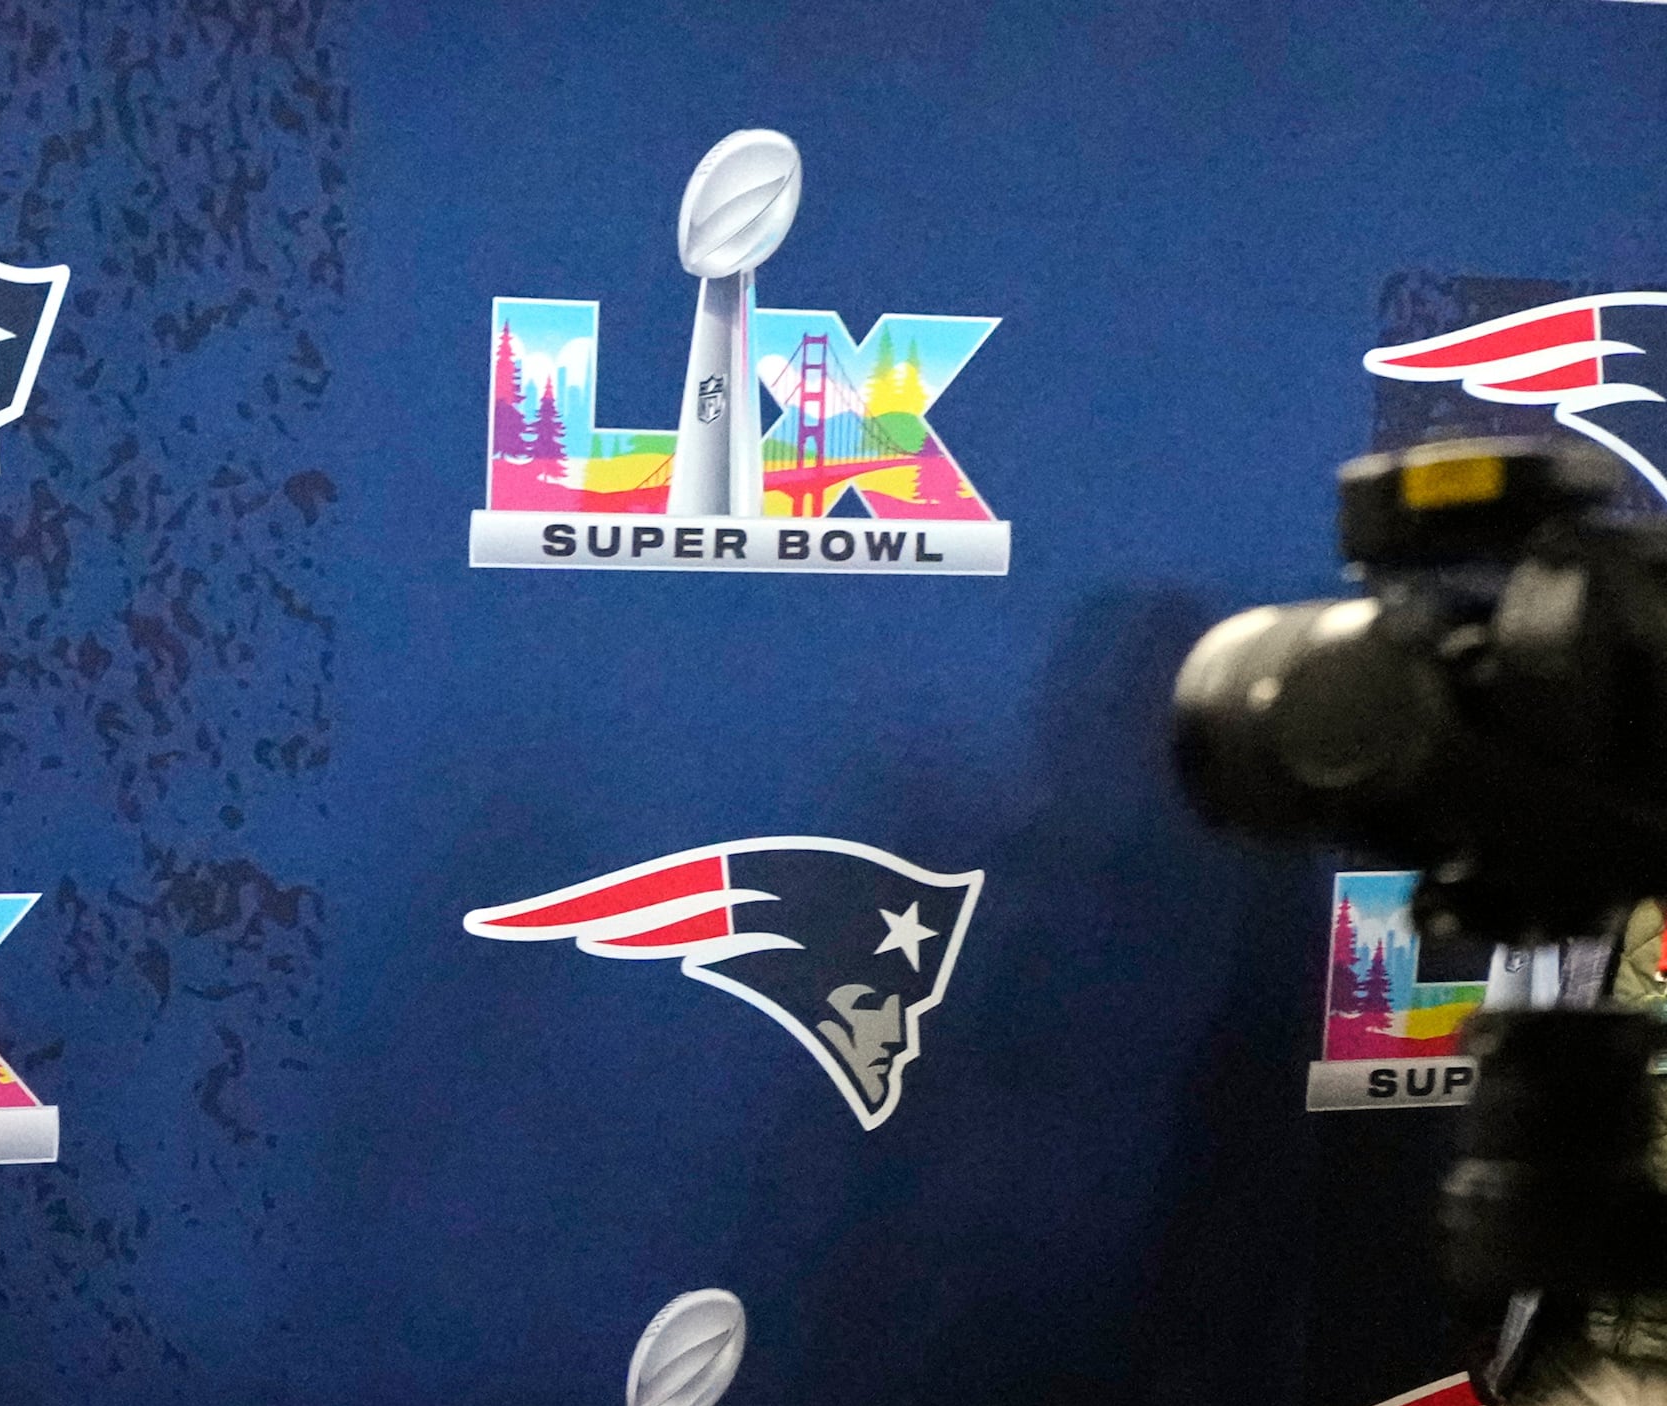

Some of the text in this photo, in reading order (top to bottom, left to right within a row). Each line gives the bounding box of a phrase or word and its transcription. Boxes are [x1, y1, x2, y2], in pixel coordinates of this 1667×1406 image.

[542, 524, 944, 563] SUPER BOWL
[1366, 1066, 1474, 1100] SUP
